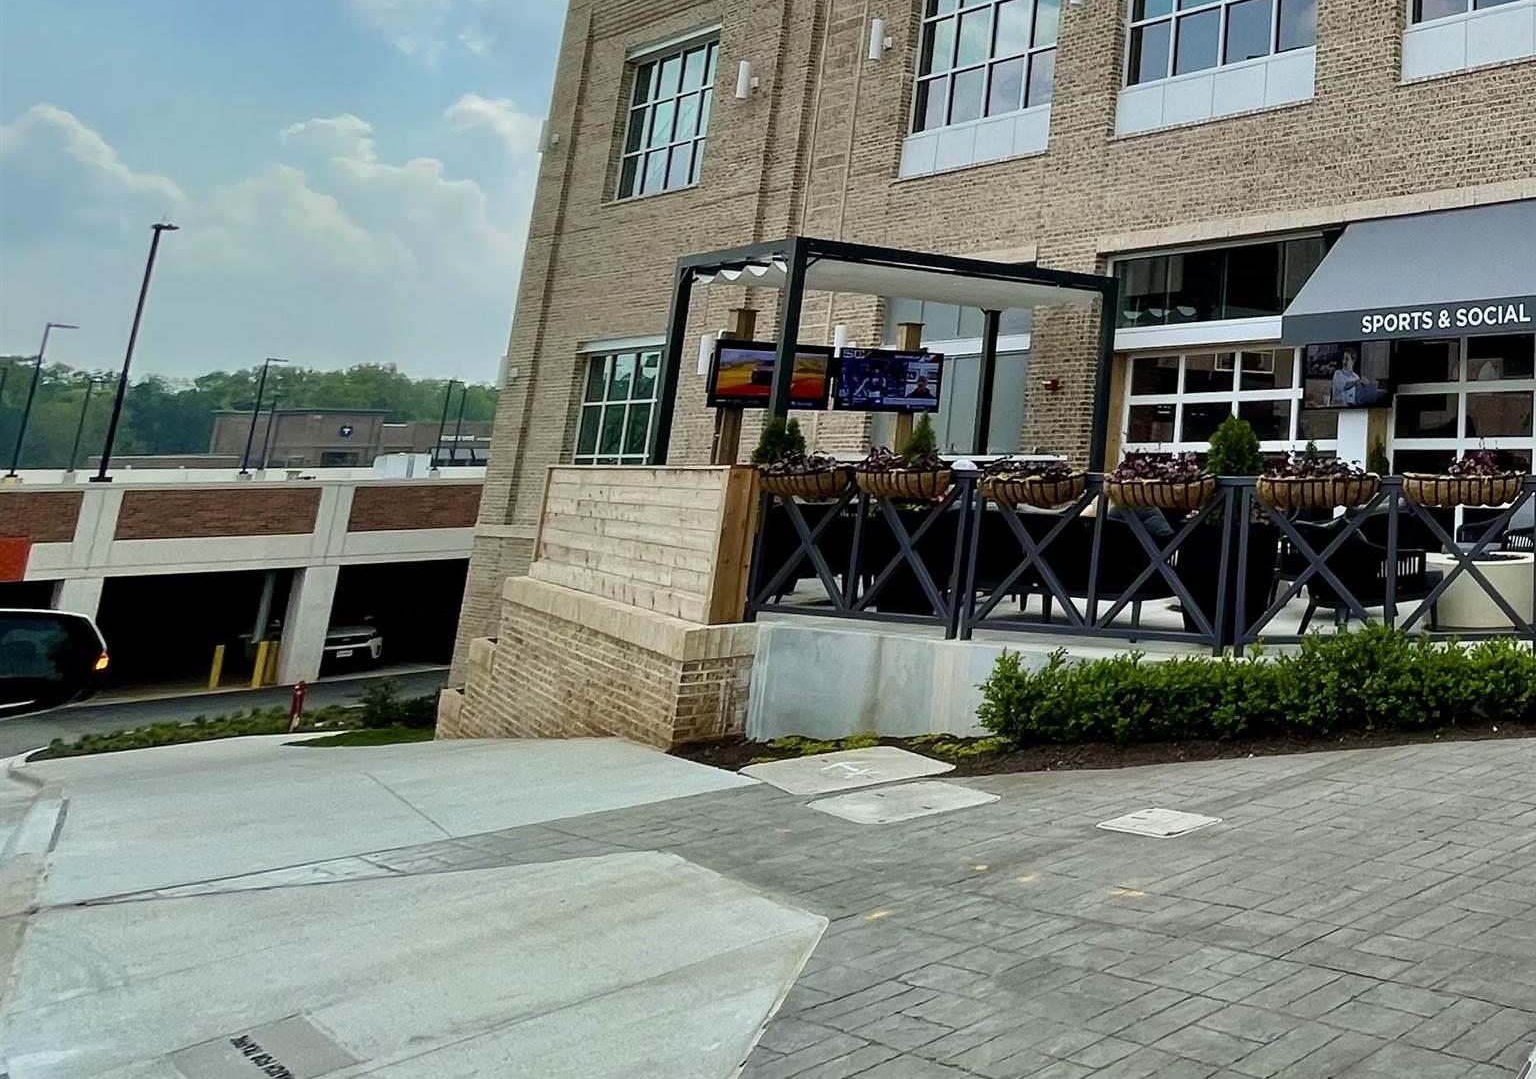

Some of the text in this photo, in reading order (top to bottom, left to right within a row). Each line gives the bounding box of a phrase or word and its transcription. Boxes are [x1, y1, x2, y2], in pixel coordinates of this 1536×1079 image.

[1361, 303, 1531, 333] SPORTS & SOCIAL
